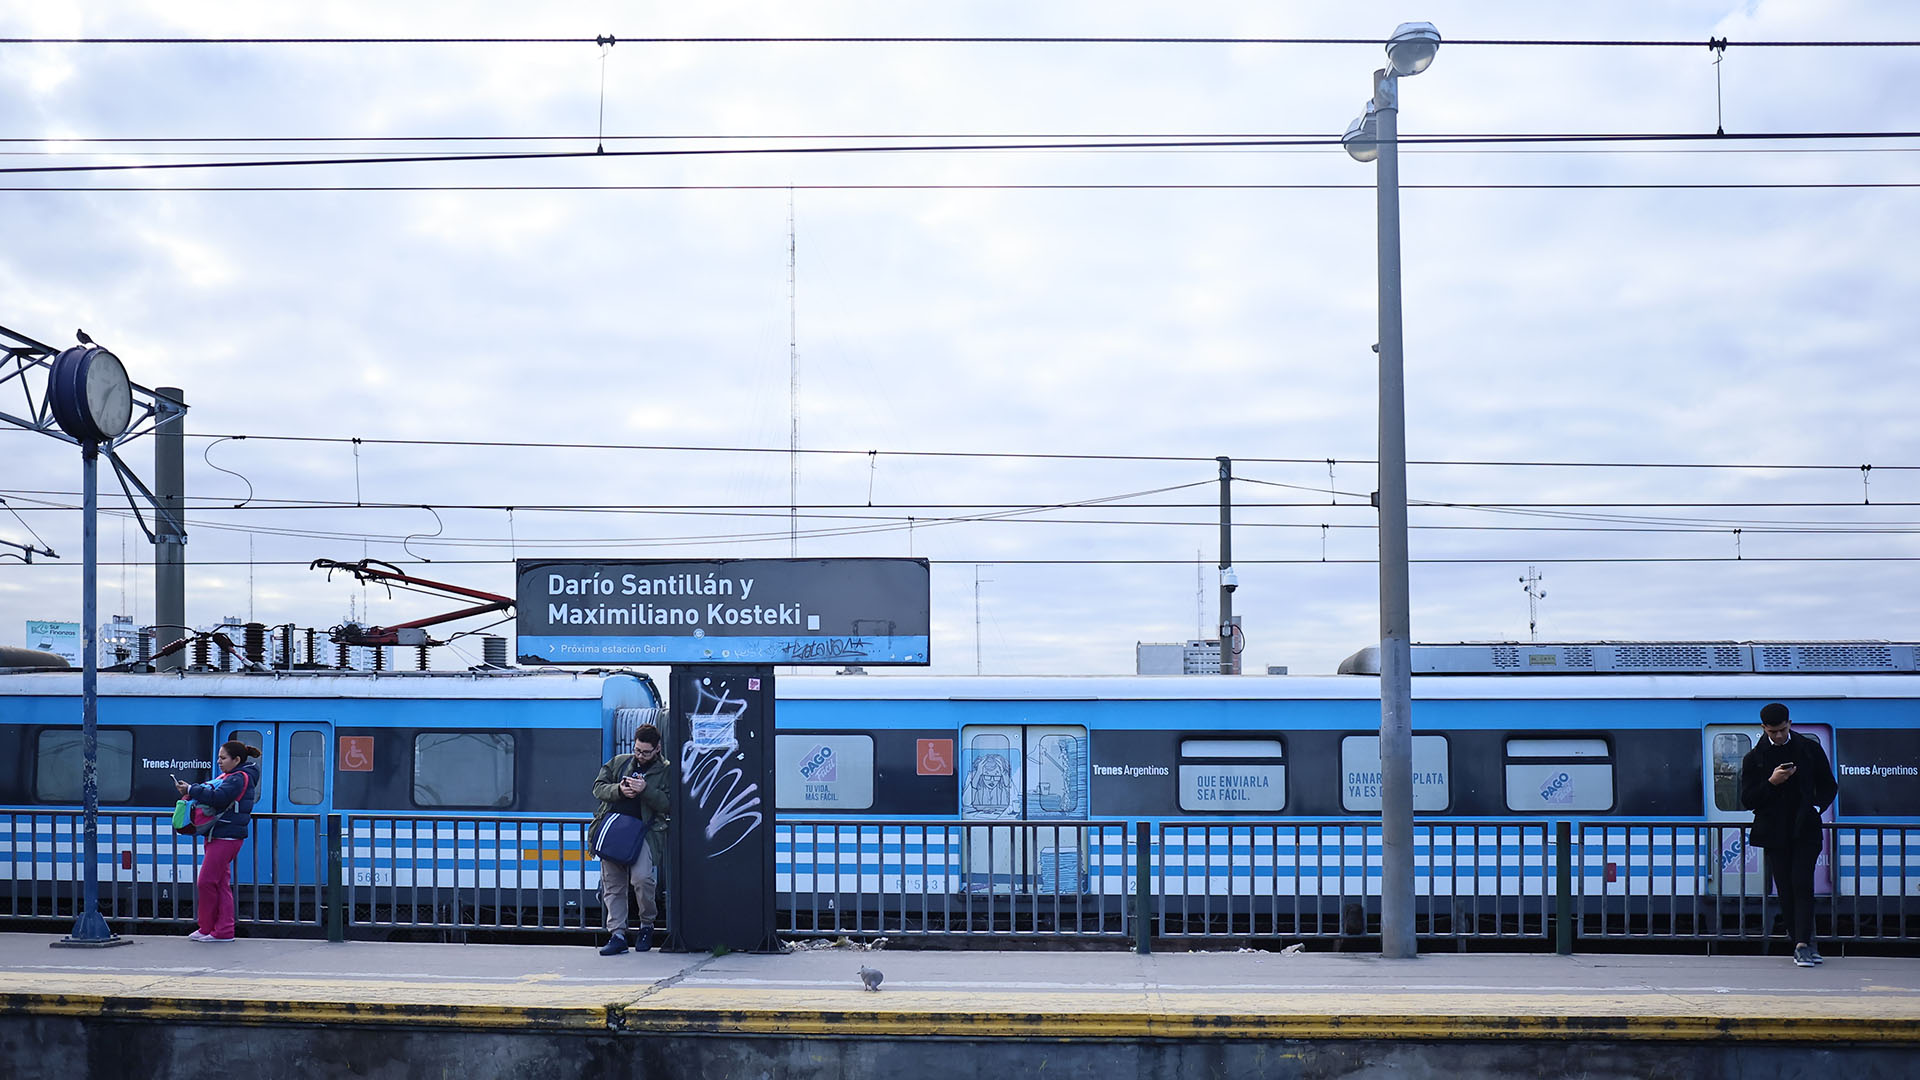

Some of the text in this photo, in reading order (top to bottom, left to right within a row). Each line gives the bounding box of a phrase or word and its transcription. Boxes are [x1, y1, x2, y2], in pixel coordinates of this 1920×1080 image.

[549, 572, 754, 600] Darío Santillán y
[548, 603, 801, 626] Maximiliano Kosteki
[560, 643, 667, 654] Próxima estación Gerli
[142, 758, 212, 771] Trenes Argentinos
[800, 746, 832, 778] PAGO
[1092, 764, 1169, 778] Trenes Argentinos
[1839, 764, 1919, 778] Trenes Argentinos
[1197, 775, 1269, 788] QUE ENVIARLA
[1348, 772, 1444, 785] GANAR PLATA
[1348, 785, 1362, 798] YA
[1364, 785, 1377, 798] ES
[1540, 772, 1569, 801] PAGO
[1197, 788, 1217, 801] SEA
